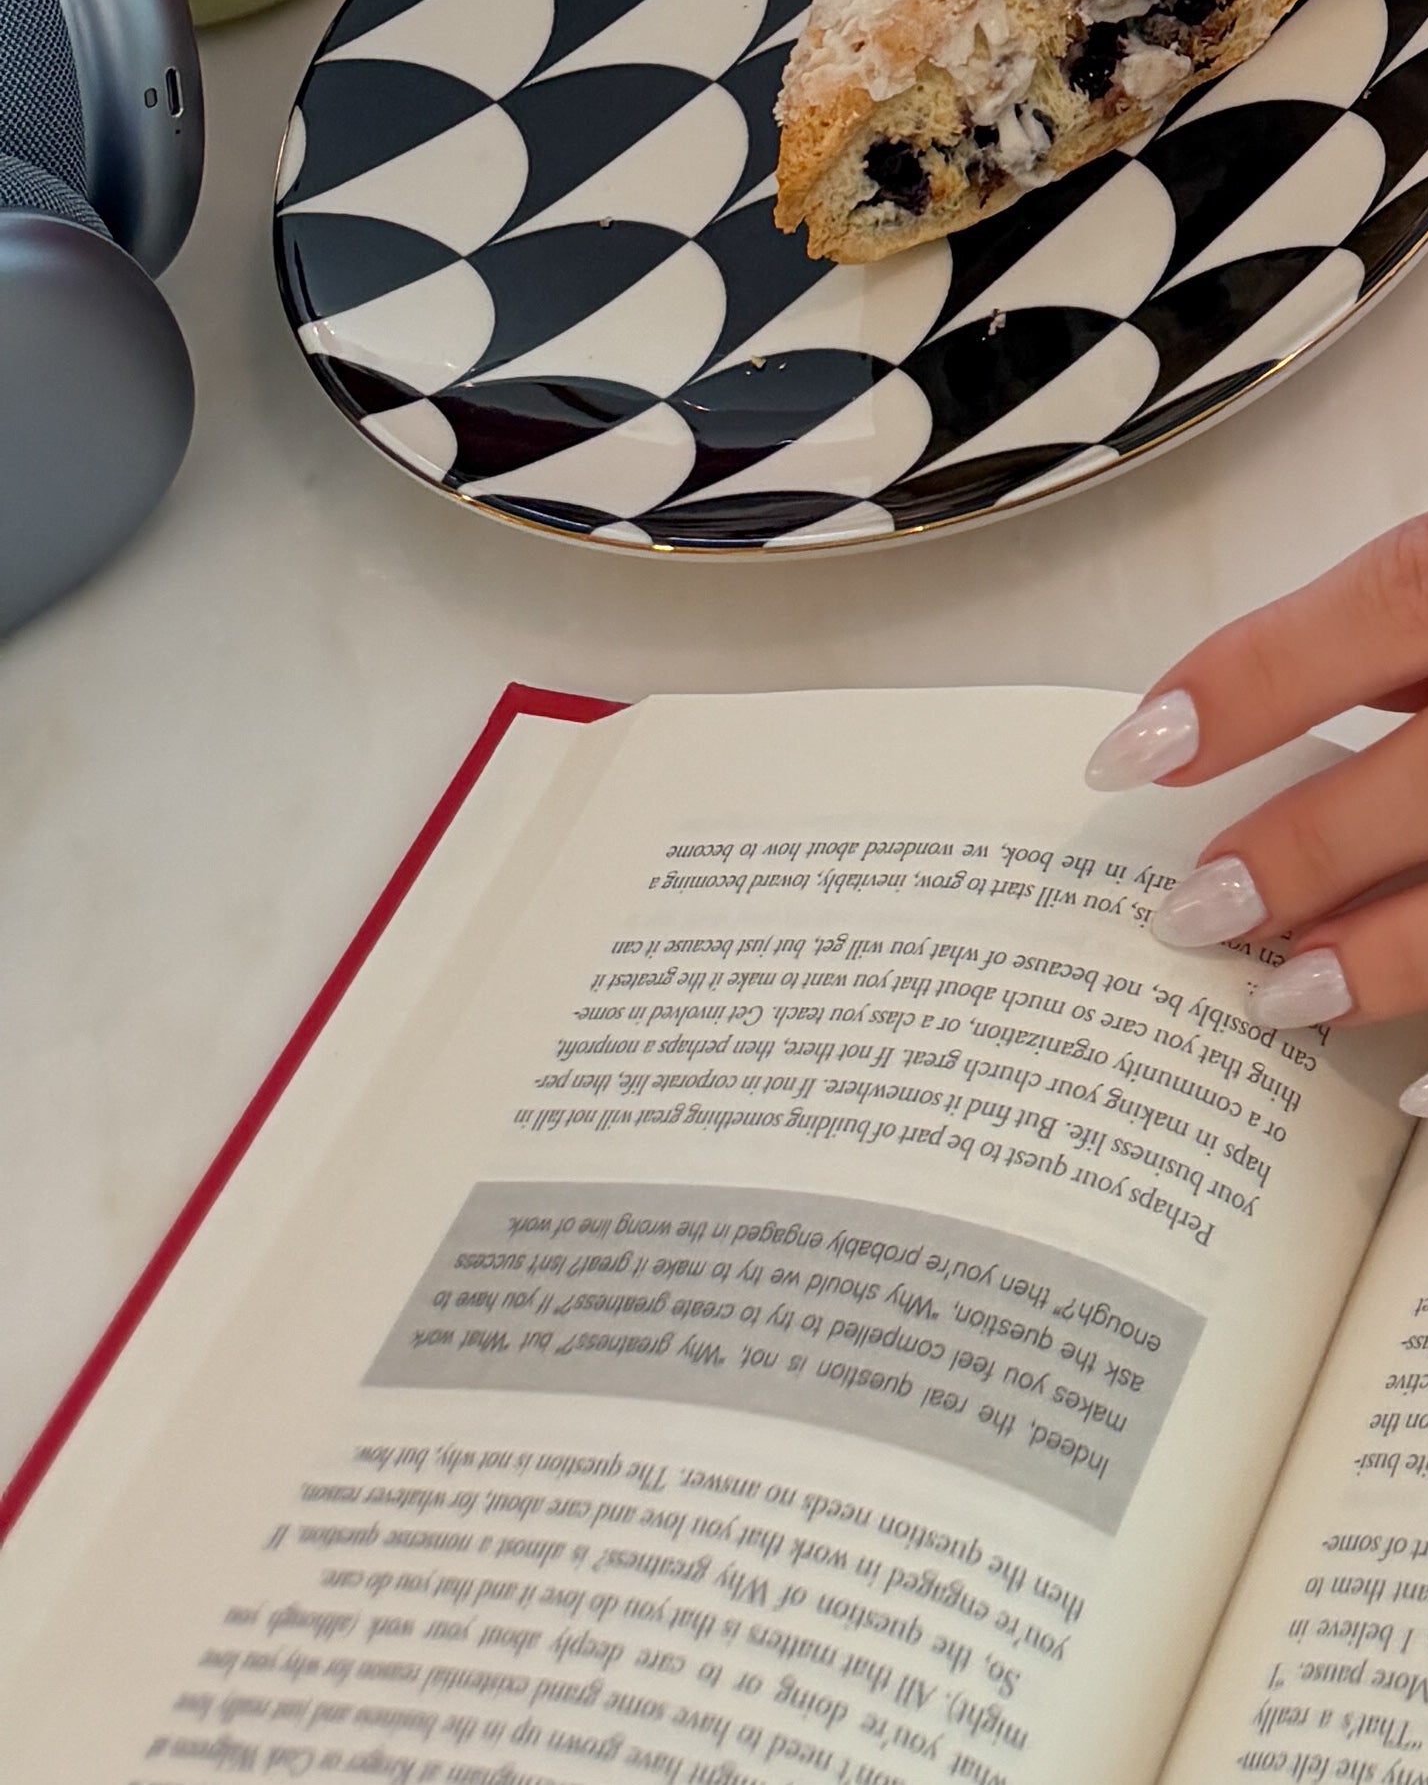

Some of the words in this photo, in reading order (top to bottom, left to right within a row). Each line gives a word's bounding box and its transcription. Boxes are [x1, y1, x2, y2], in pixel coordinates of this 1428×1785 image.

[665, 843, 735, 864] become
[739, 842, 758, 860] to
[761, 842, 803, 863] how
[805, 841, 860, 862] about
[860, 841, 954, 862] wondered
[961, 844, 989, 858] we
[1001, 843, 1055, 873] book,
[1061, 854, 1097, 880] the
[1104, 862, 1128, 885] in
[1133, 865, 1177, 894] arly
[513, 1109, 535, 1129] in
[530, 1109, 567, 1132] fall
[564, 1109, 599, 1128] not
[594, 1109, 633, 1132] will
[633, 1102, 687, 1127] great
[682, 1102, 785, 1133] something
[783, 1106, 872, 1143] building
[867, 1121, 897, 1145] of
[897, 1124, 949, 1146] part
[946, 1134, 976, 1162] be
[979, 1141, 1003, 1163] to
[1003, 1147, 1068, 1177] quest
[1069, 1167, 1129, 1198] your
[1127, 1186, 1216, 1248] Perhaps
[432, 1290, 453, 1311] to
[455, 1291, 500, 1313] have
[500, 1285, 542, 1310] you
[534, 1293, 555, 1315] If
[670, 1299, 736, 1321] create
[739, 1304, 763, 1328] to
[764, 1302, 796, 1333] try
[800, 1313, 825, 1338] to
[410, 1328, 455, 1349] work
[518, 1331, 555, 1354] but
[825, 1319, 946, 1361] compelled
[786, 1354, 809, 1377] is
[948, 1349, 996, 1383] feel
[815, 1360, 914, 1398] question
[1002, 1366, 1051, 1396] you
[919, 1386, 969, 1414] real
[1051, 1385, 1128, 1433] makes
[977, 1404, 1017, 1438] the
[1369, 1412, 1401, 1437] the
[1353, 1452, 1402, 1478] busi-
